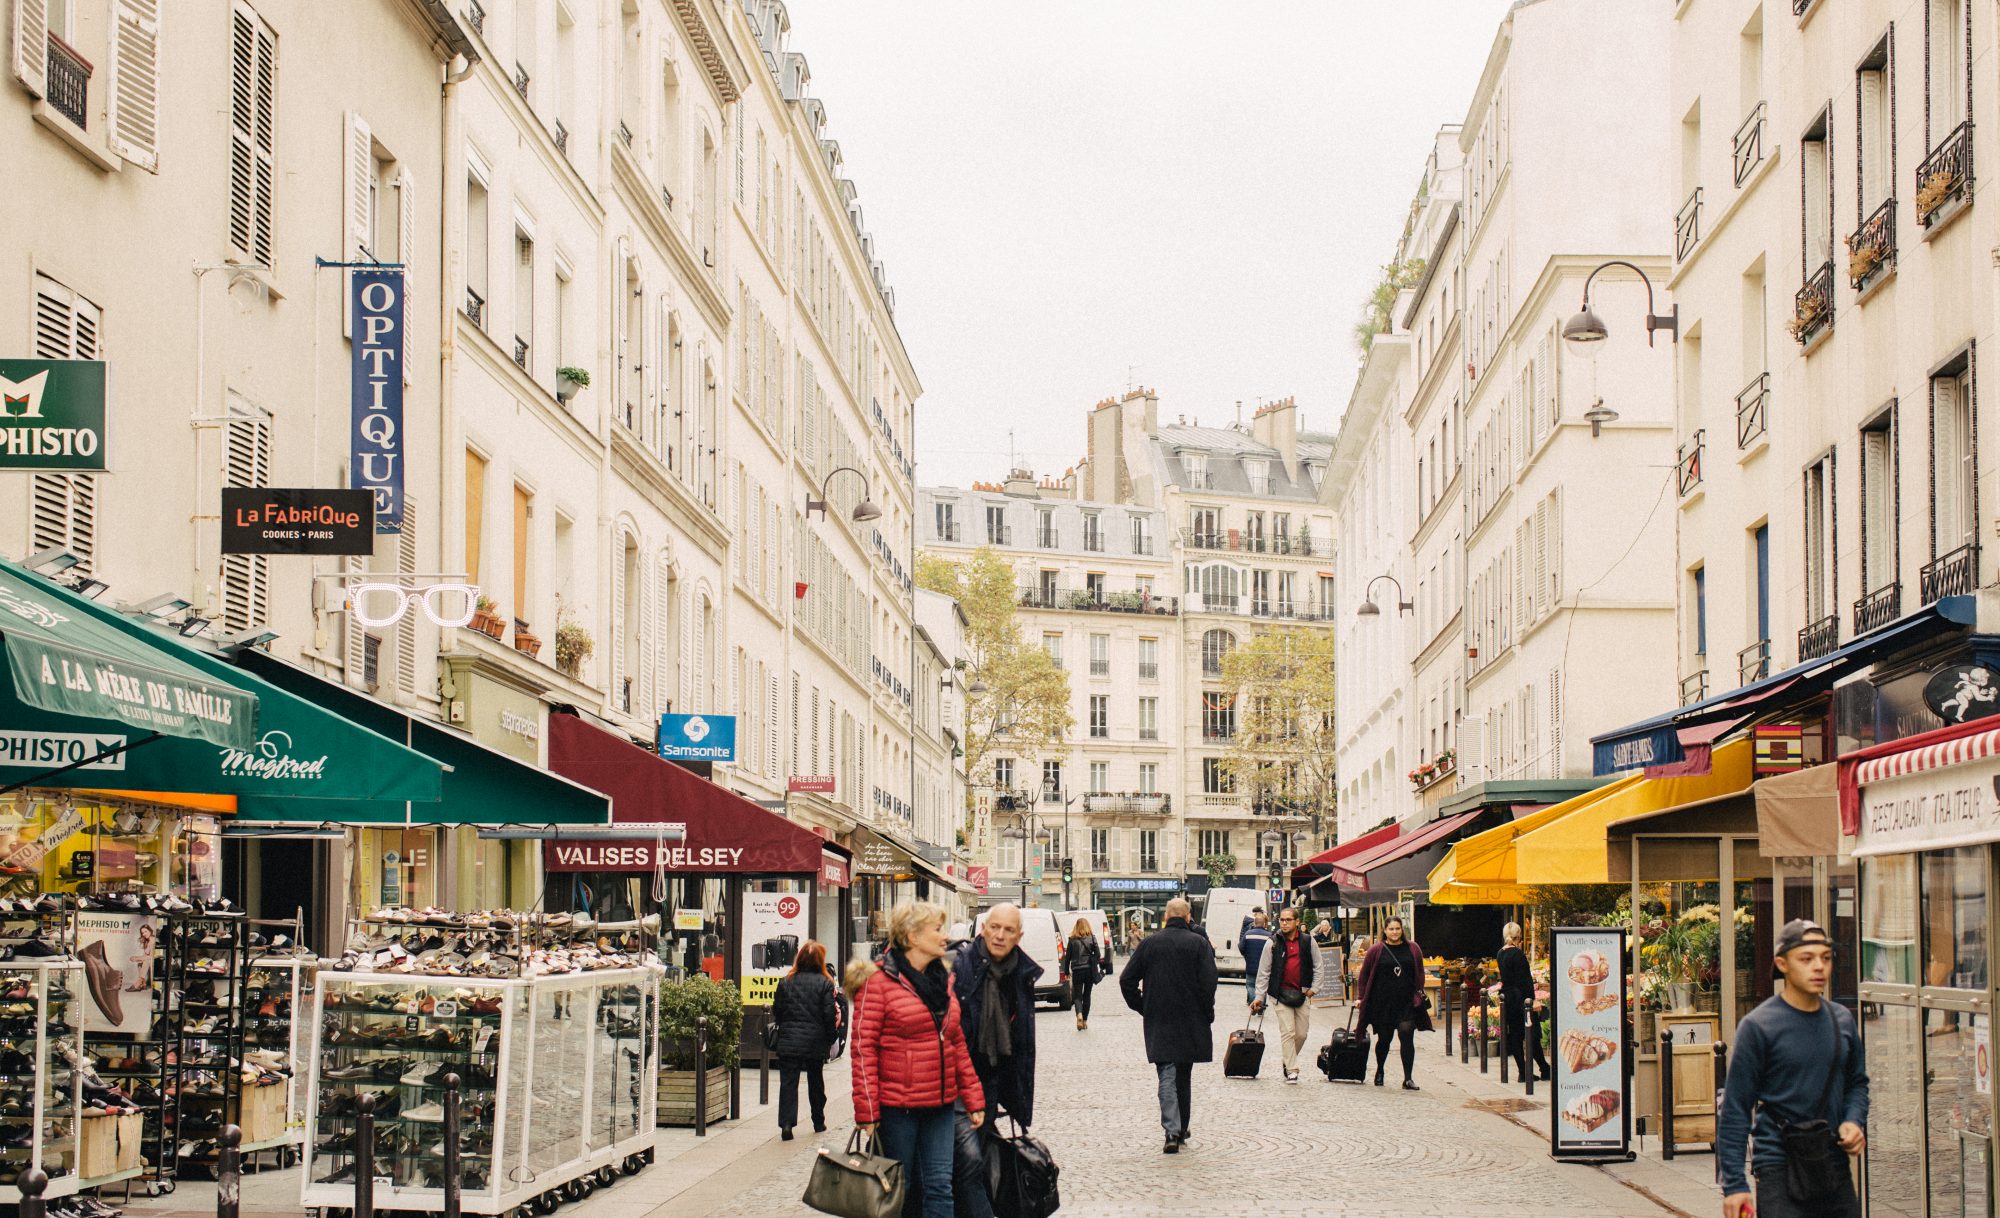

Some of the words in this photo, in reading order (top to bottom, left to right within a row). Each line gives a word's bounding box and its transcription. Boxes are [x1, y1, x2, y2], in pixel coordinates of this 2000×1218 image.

[359, 282, 396, 516] OPTIQUE
[236, 508, 258, 527] La
[262, 530, 300, 539] COOKIES
[308, 530, 334, 539] PARIS
[41, 654, 56, 685] A
[62, 660, 92, 692] LA
[146, 682, 172, 710] DE
[173, 687, 232, 725] FAMILLE
[664, 744, 730, 758] Samsonite
[1614, 742, 1632, 768] SAINT
[1632, 736, 1654, 763] JAMES
[1872, 797, 1927, 834] RESTAURANT
[1934, 786, 1982, 824] TRAITEUR
[978, 796, 988, 848] HOTEL
[556, 847, 648, 865] VALISES
[656, 847, 744, 866] DELSEY
[876, 864, 905, 873] Affaires
[1102, 880, 1135, 889] RECORD
[1138, 880, 1178, 889] PRESSING
[78, 920, 119, 928] MEPHISTO
[752, 977, 782, 985] SUP
[750, 991, 775, 999] PRO
[1592, 1025, 1618, 1033] Crêpes
